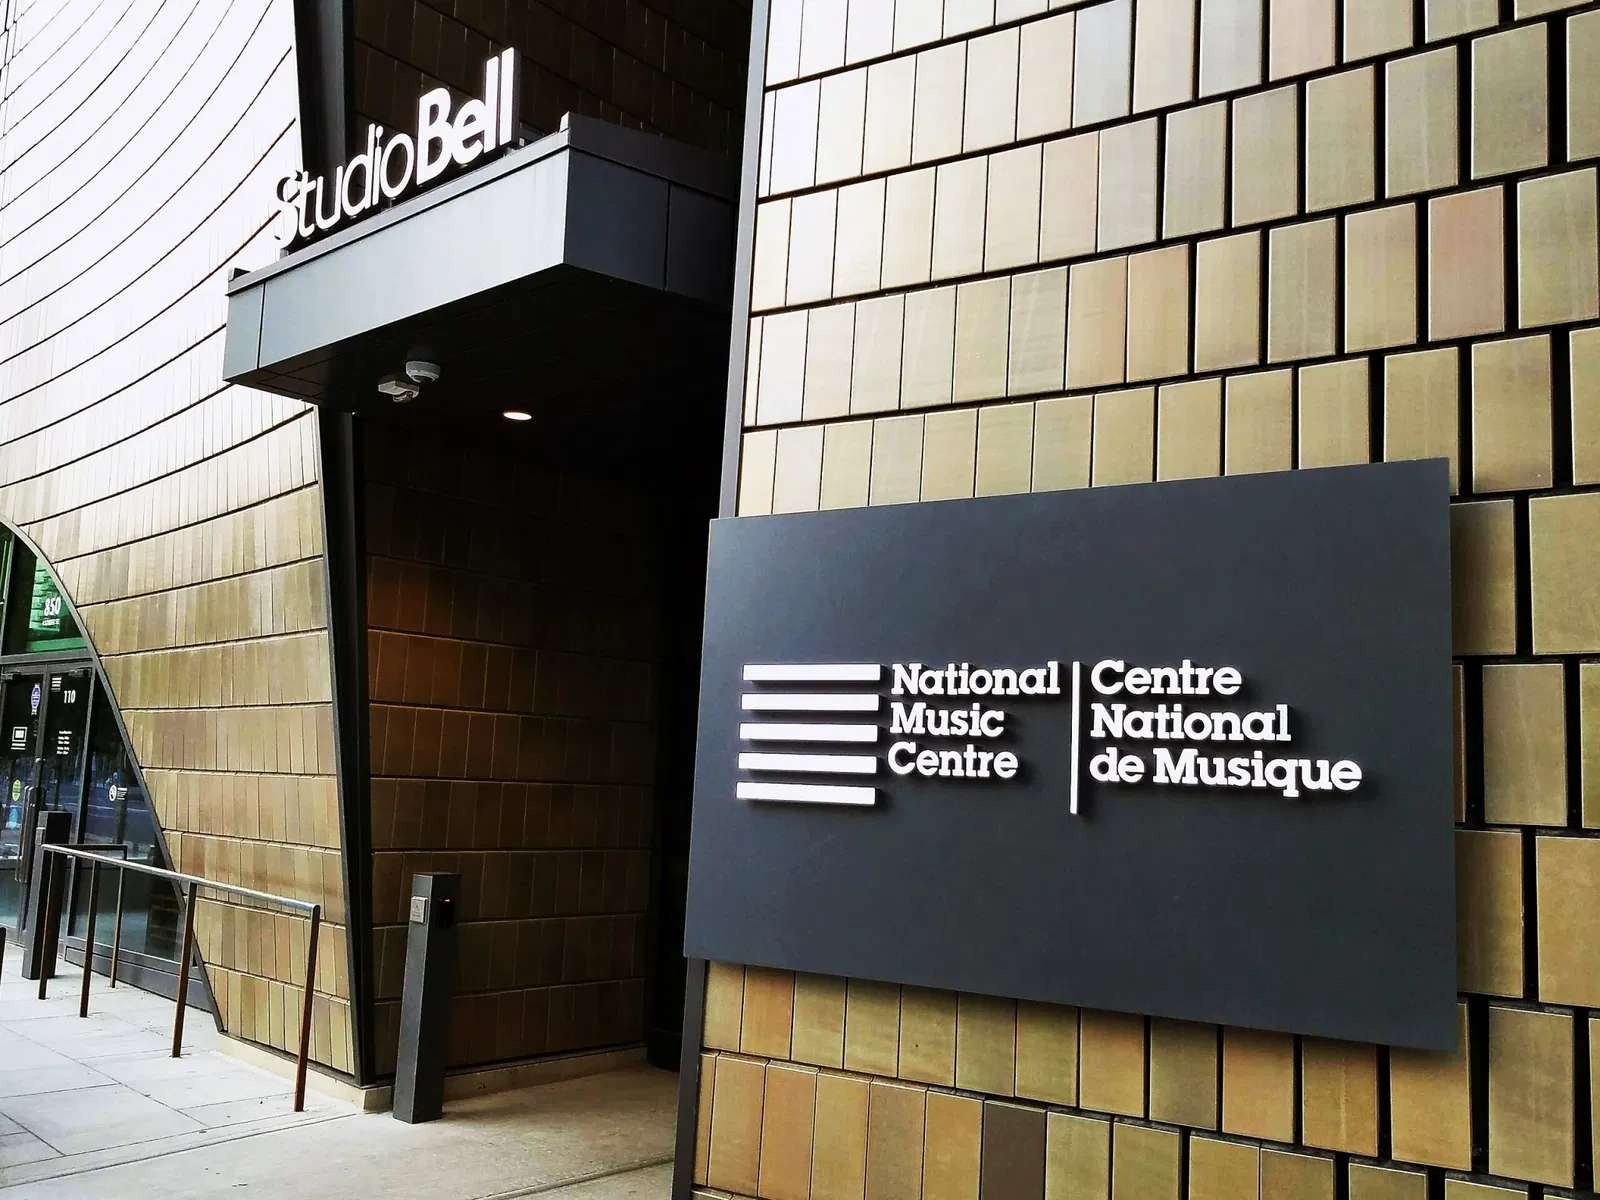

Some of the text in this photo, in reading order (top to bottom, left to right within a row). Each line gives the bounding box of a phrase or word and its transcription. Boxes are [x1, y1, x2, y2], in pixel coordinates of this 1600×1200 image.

[43, 596, 61, 616] 850
[889, 660, 1061, 697] National
[1090, 658, 1242, 696] Centre
[63, 689, 76, 704] 110
[889, 701, 1005, 738] Music
[1090, 702, 1292, 742] National
[887, 741, 1020, 779] Centre
[1089, 745, 1363, 798] de Musique
